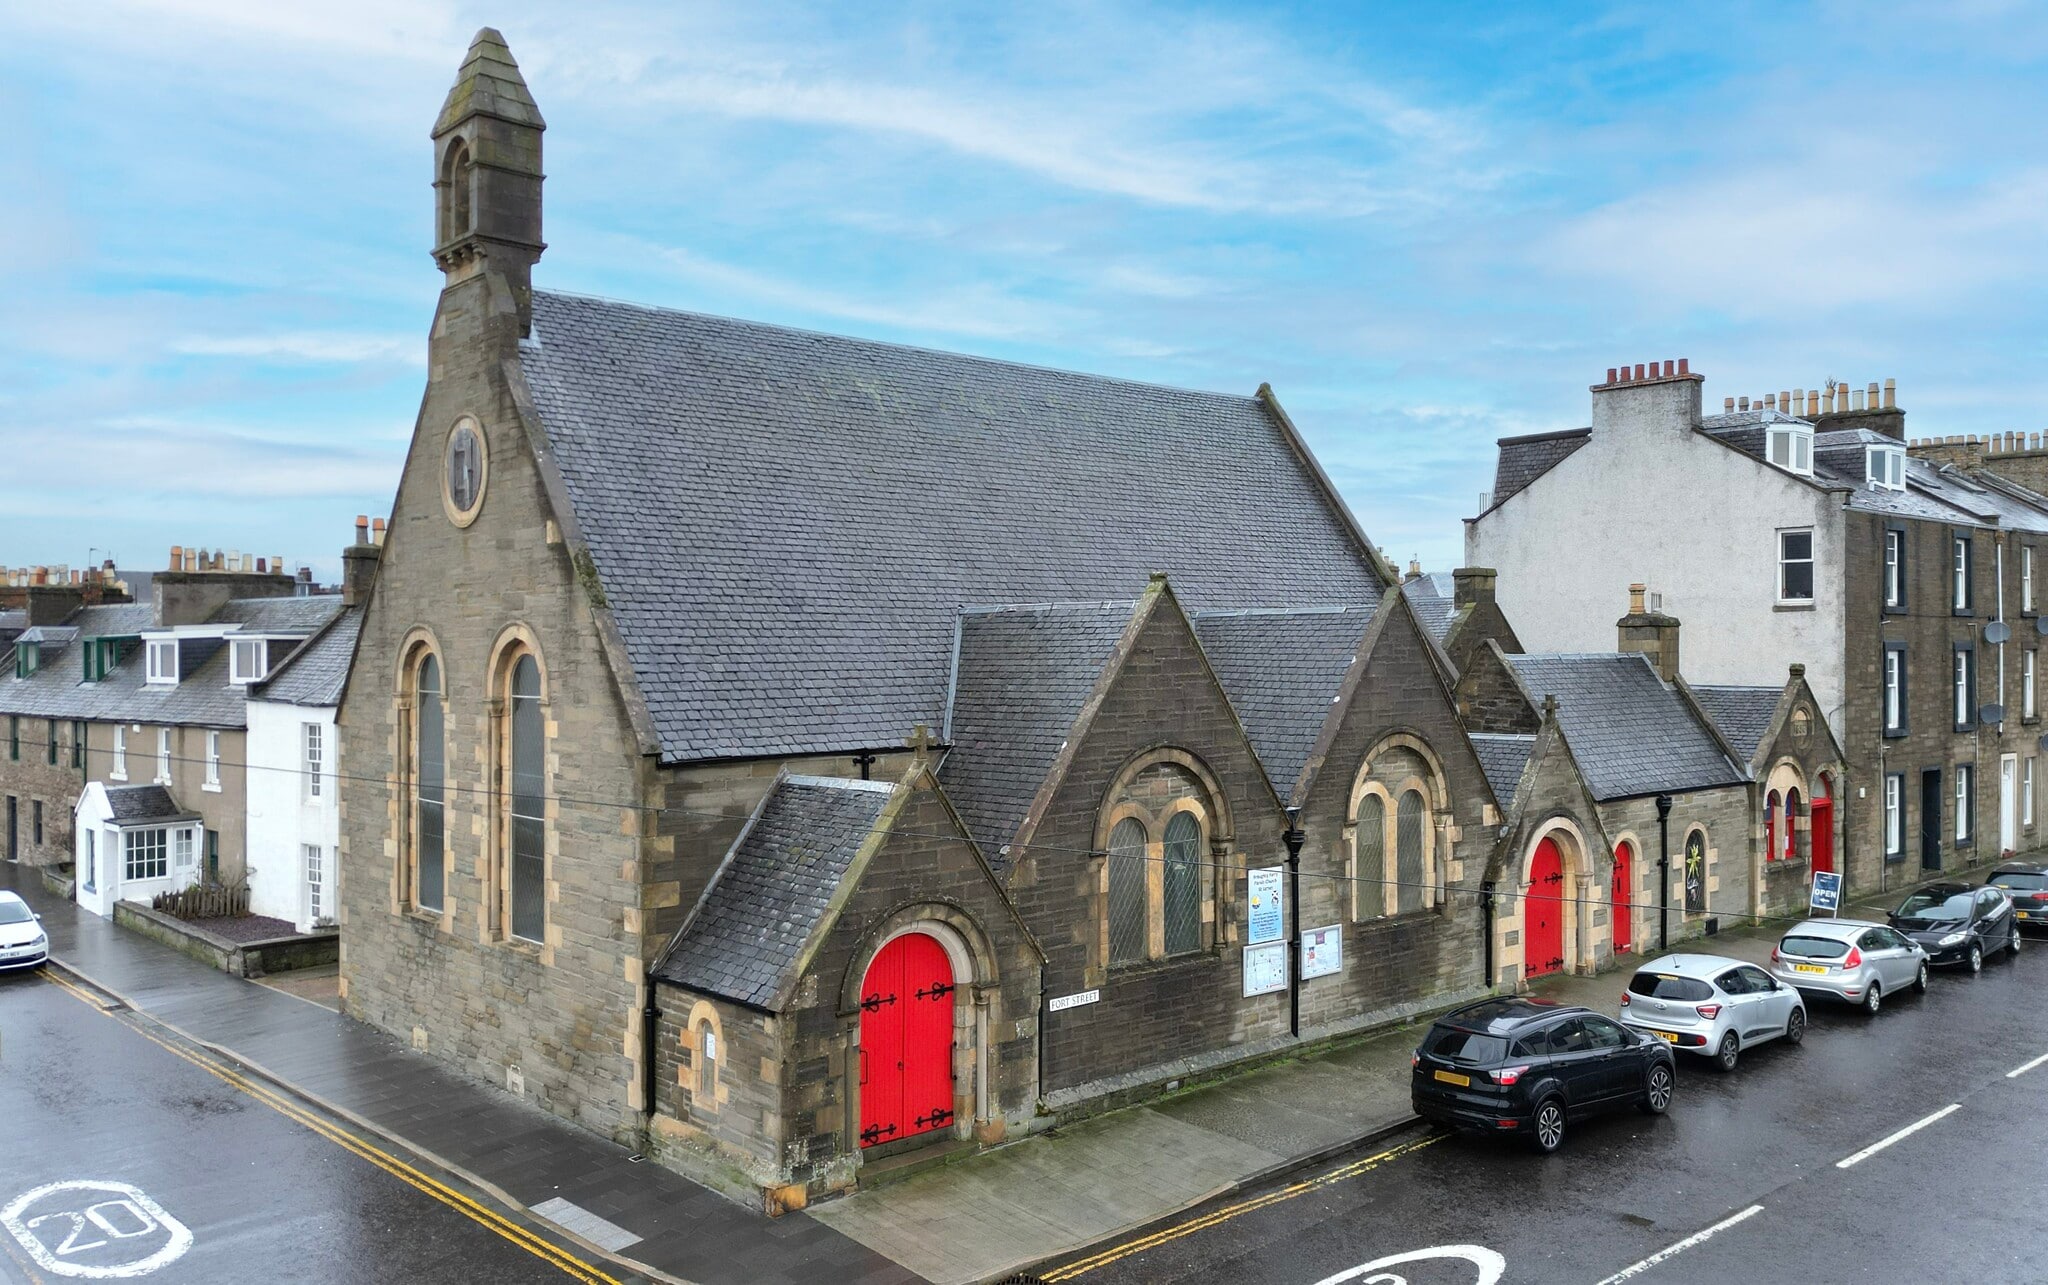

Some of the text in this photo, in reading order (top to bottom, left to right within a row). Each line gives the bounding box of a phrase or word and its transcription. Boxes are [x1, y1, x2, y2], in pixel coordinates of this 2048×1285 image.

[1815, 888, 1836, 898] OPEN
[1051, 992, 1098, 1010] FORT STREET
[27, 1200, 158, 1256] 20
